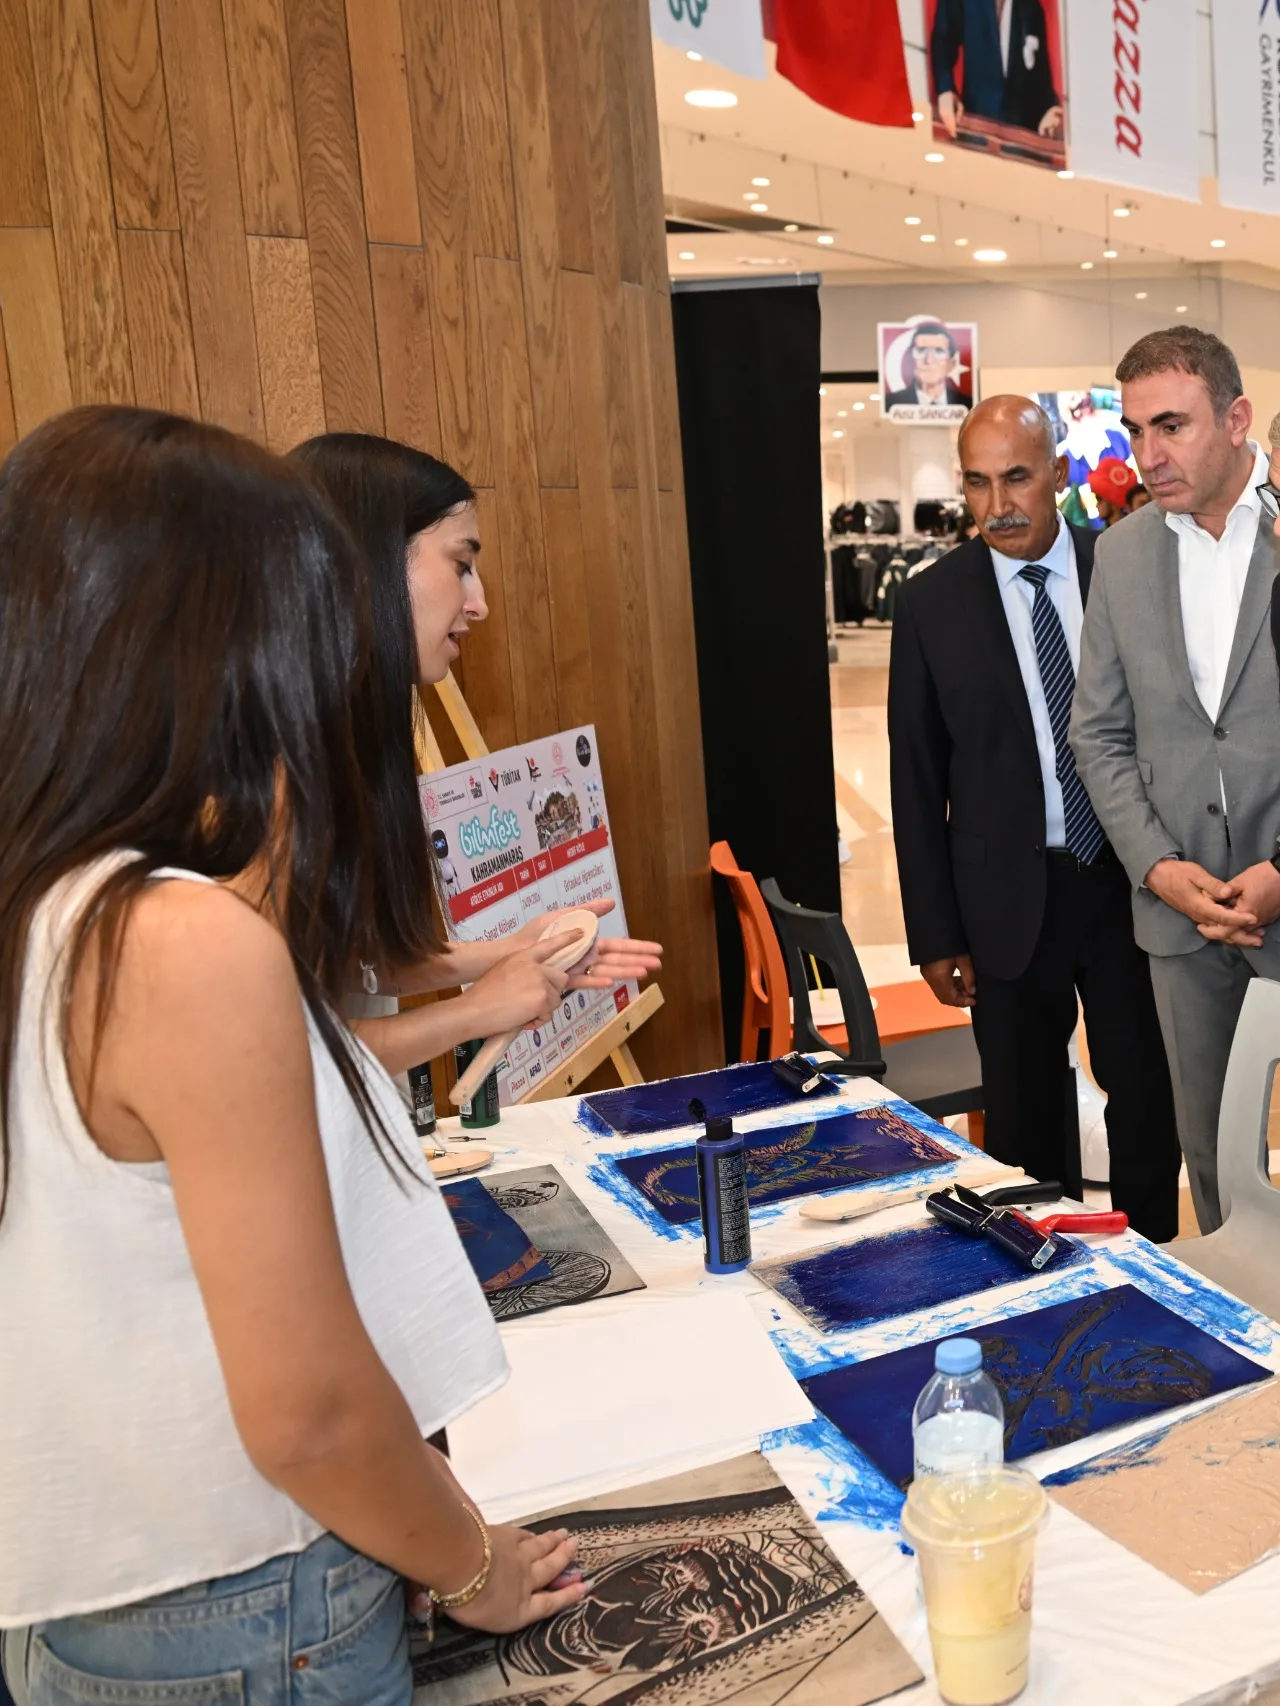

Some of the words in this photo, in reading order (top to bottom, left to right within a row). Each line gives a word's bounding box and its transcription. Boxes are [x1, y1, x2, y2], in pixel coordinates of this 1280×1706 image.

[1112, 0, 1143, 158] azza
[1258, 33, 1275, 186] GAYRİMENKUL
[500, 769, 522, 787] TÜBİTAK
[459, 804, 521, 859] bilimfest
[470, 846, 525, 884] KAHRAMANMARAŞ
[529, 1062, 542, 1079] AFAD
